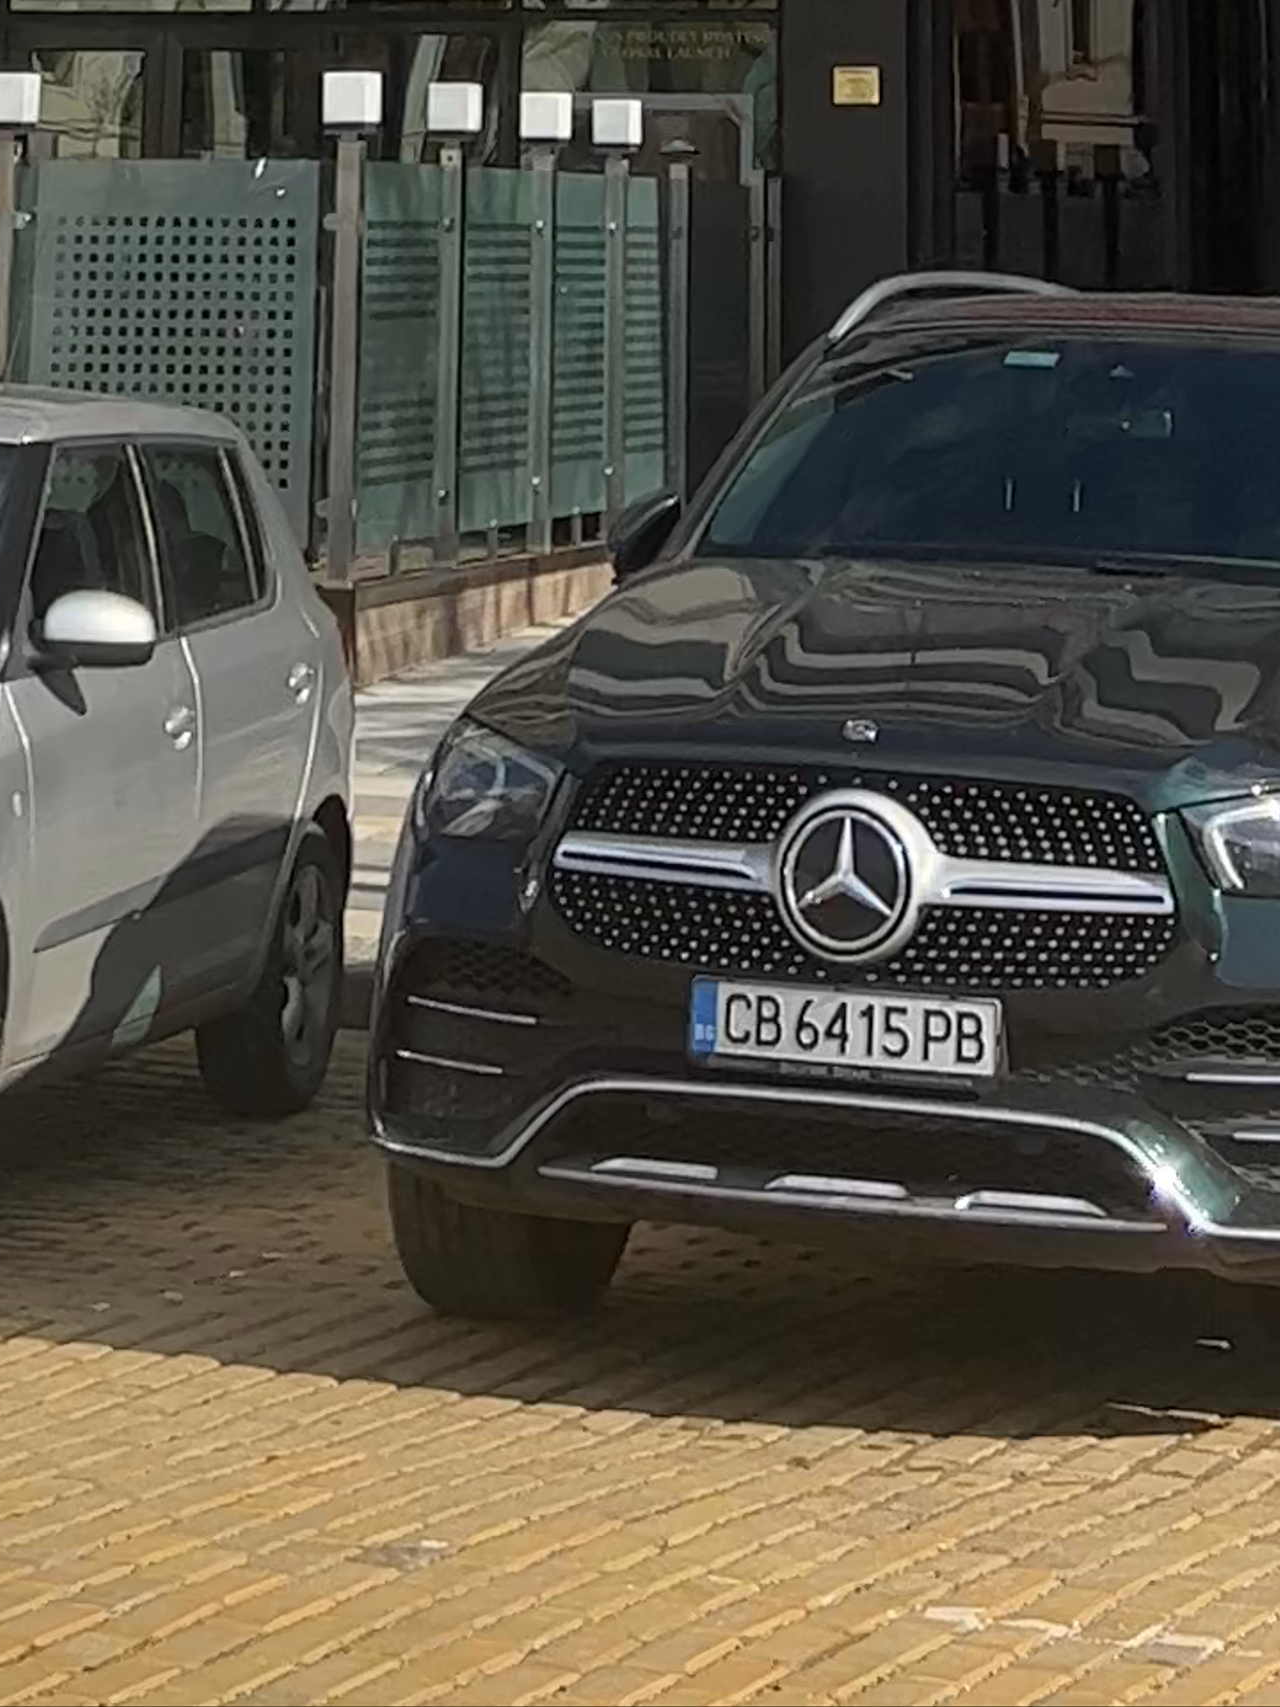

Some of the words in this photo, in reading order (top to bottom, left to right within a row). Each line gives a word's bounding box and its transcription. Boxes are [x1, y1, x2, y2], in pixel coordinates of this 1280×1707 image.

[724, 993, 783, 1047] CB
[795, 998, 910, 1059] 6415
[921, 1008, 985, 1064] PB
